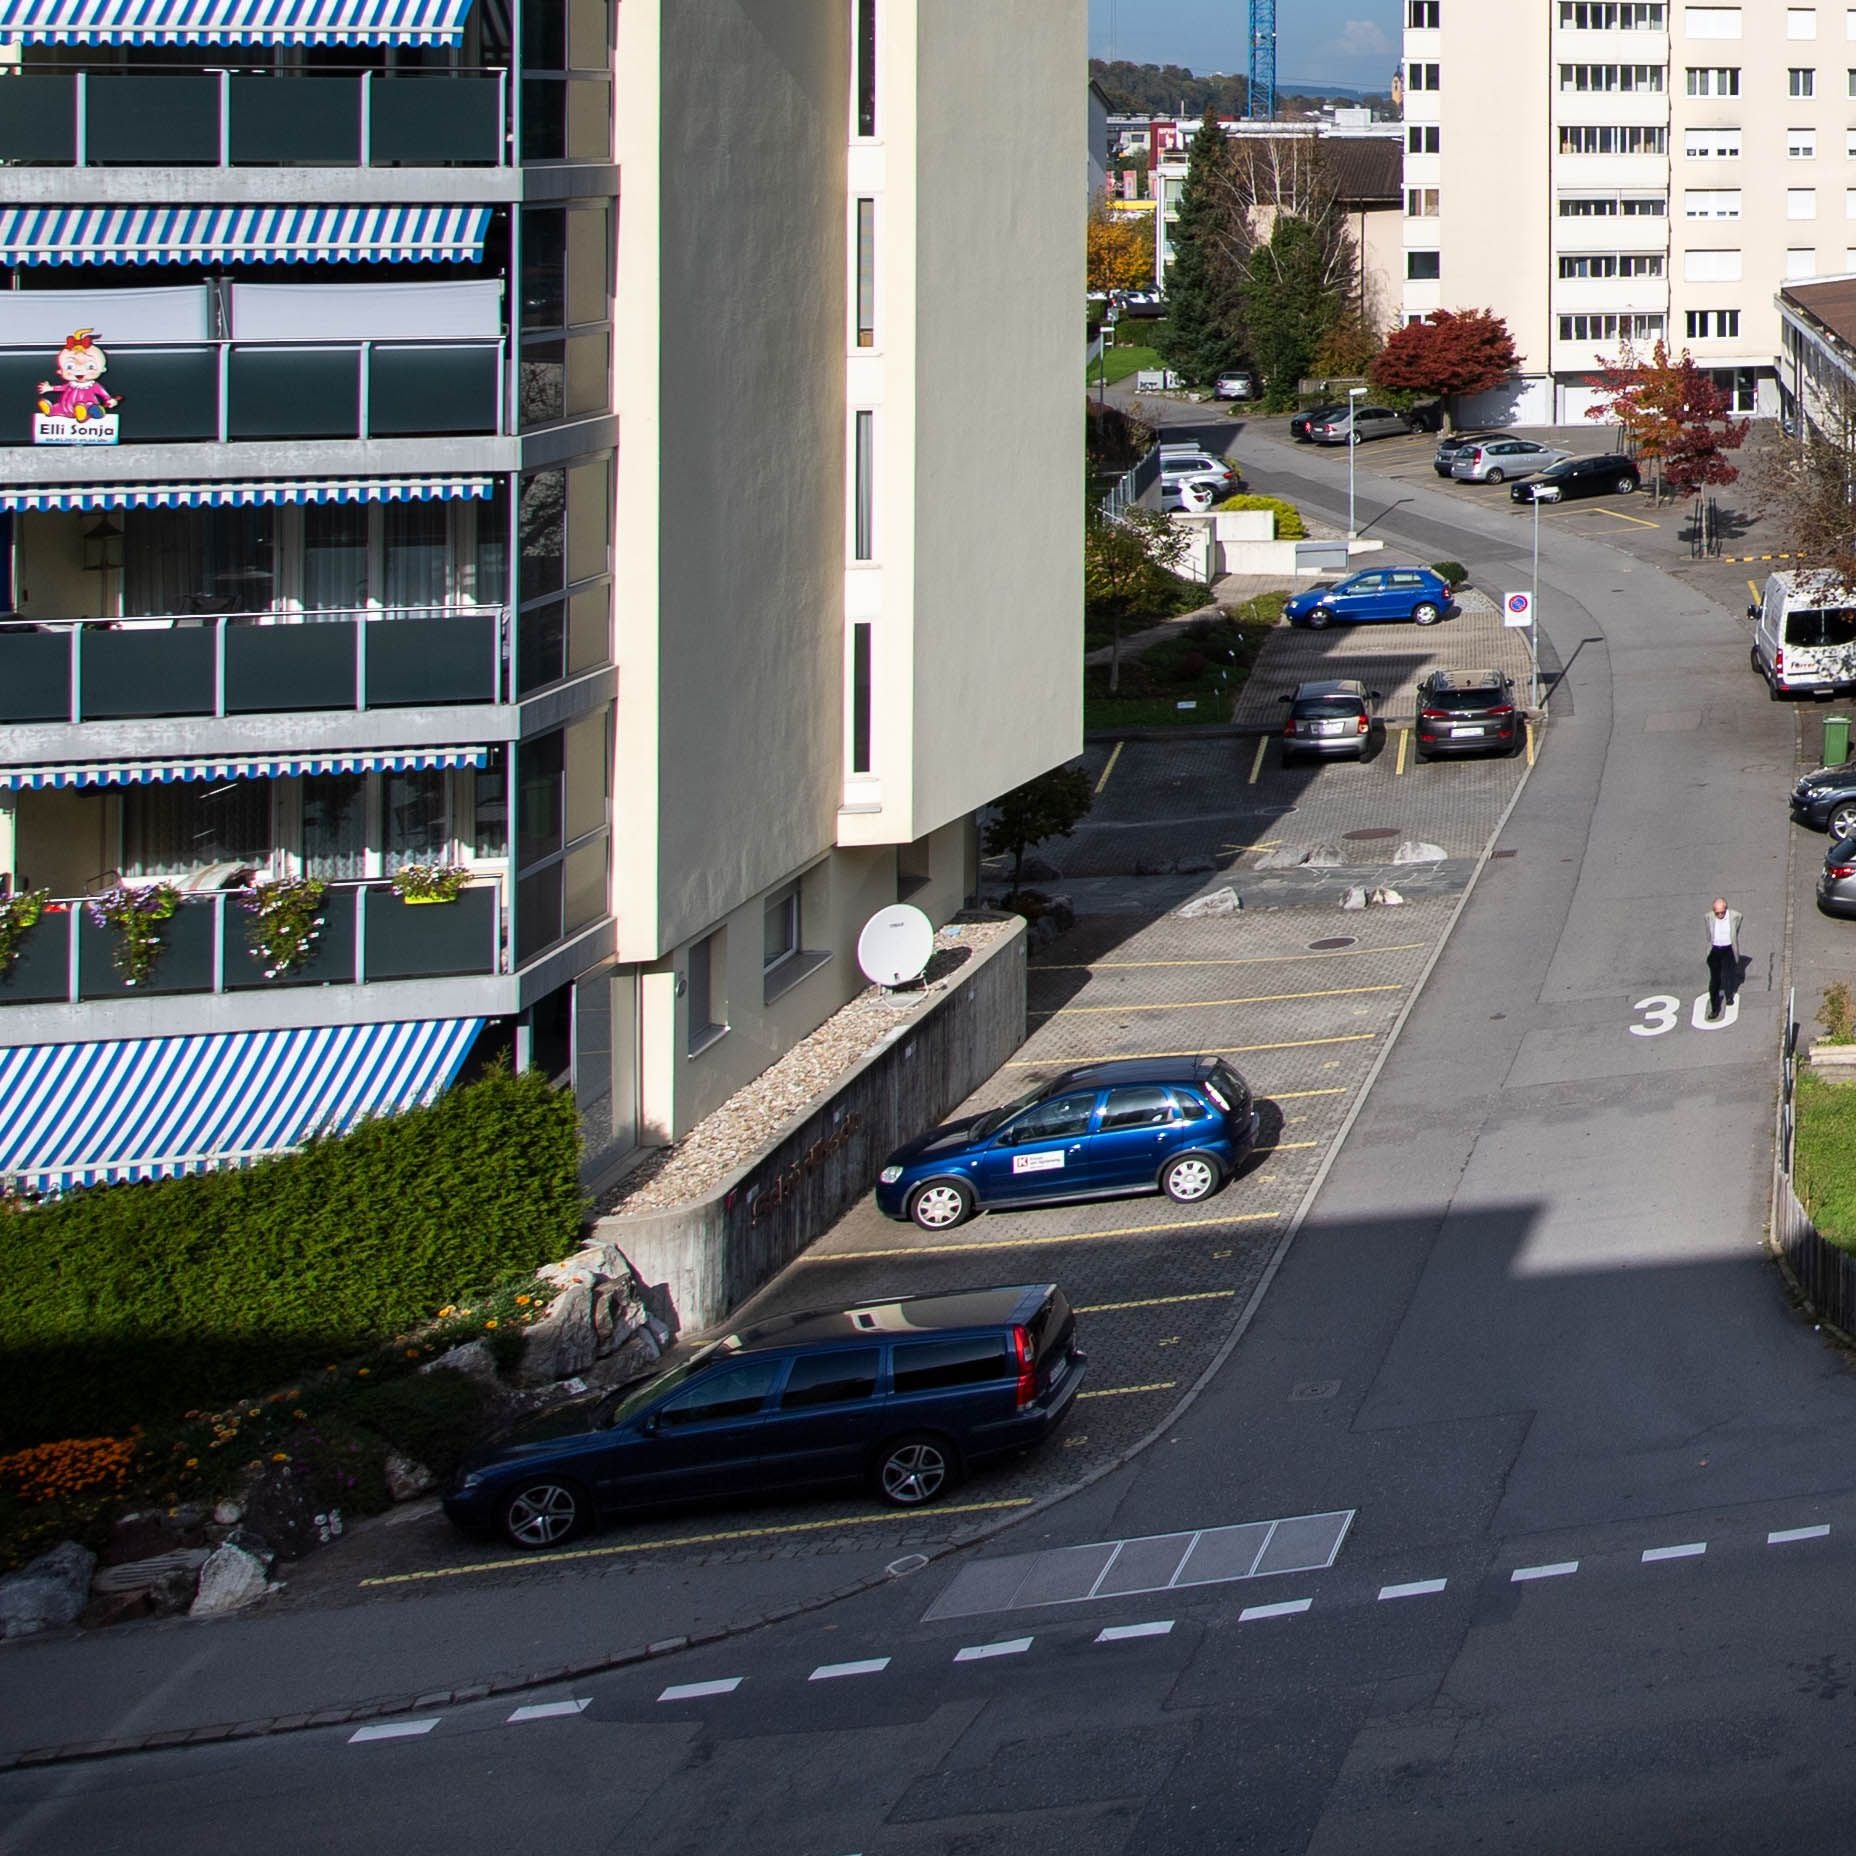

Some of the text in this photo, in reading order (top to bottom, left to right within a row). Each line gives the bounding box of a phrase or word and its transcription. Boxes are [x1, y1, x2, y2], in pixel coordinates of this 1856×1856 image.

[40, 423, 114, 437] Elli Sonja
[1629, 993, 1740, 1037] 30
